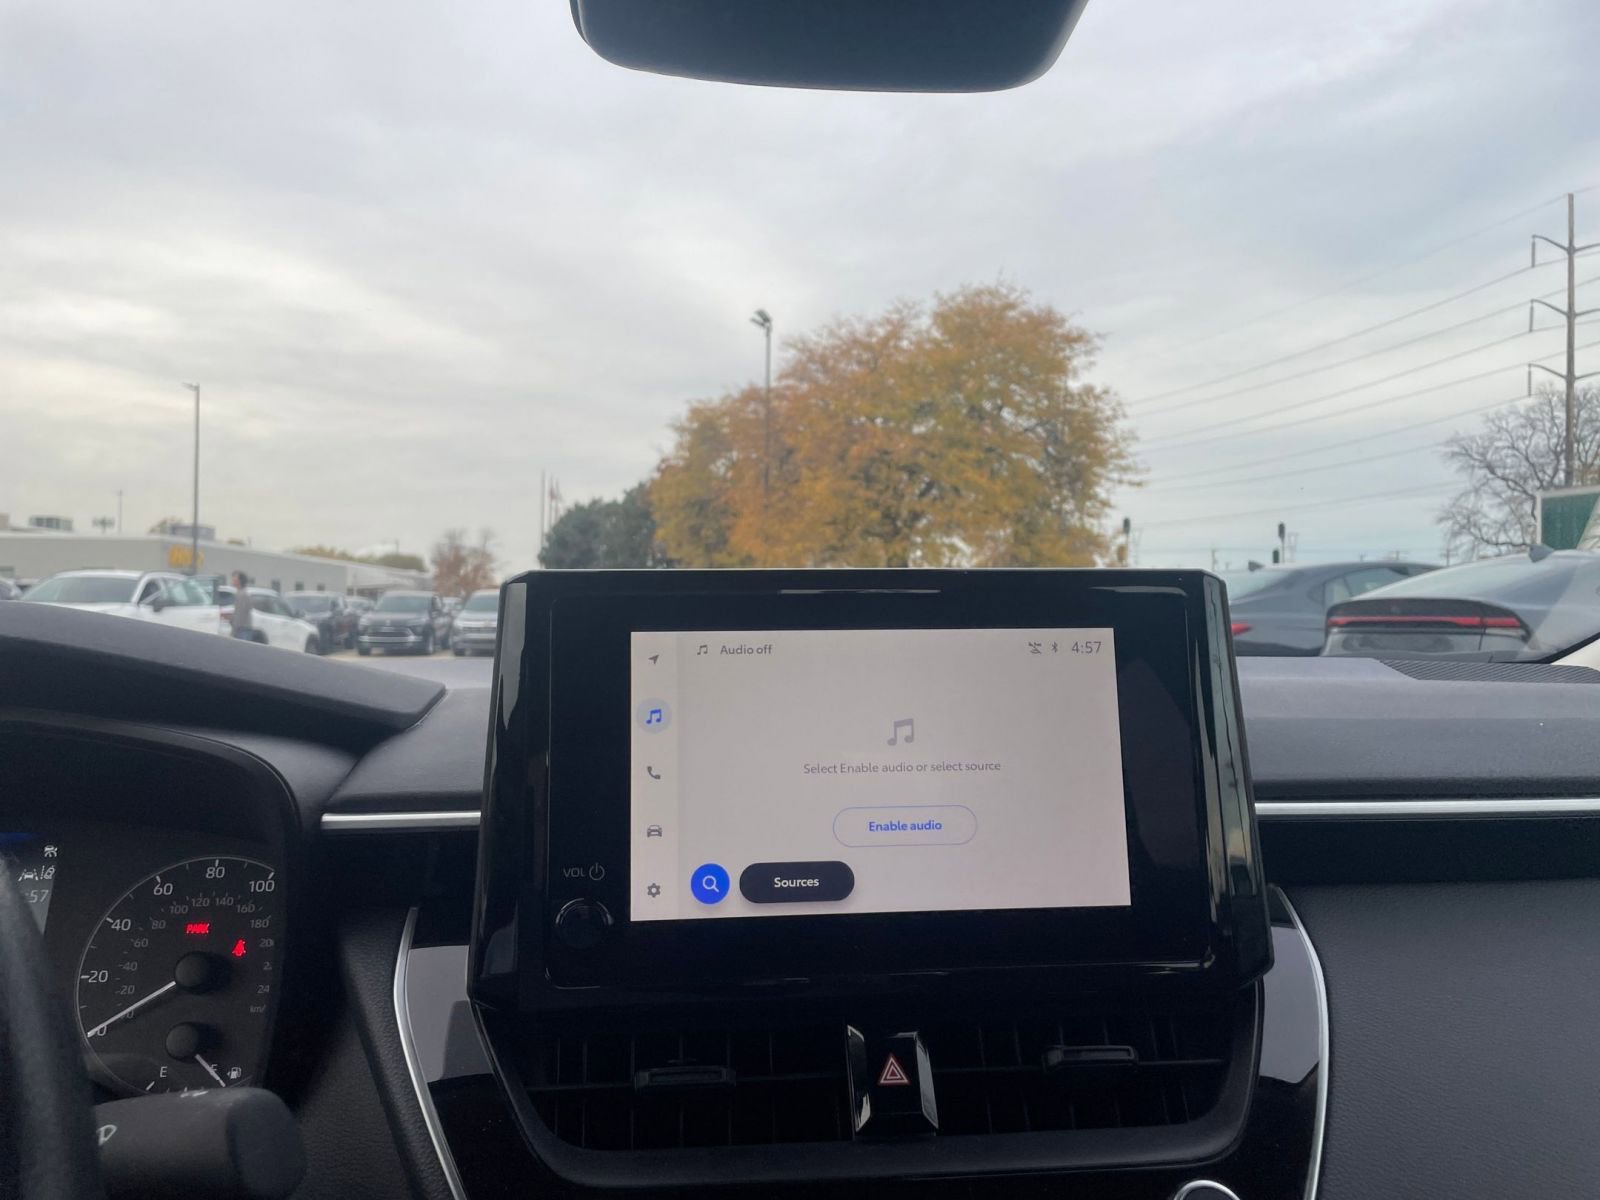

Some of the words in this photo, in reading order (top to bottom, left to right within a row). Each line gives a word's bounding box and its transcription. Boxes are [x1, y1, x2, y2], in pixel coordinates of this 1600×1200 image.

[720, 644, 754, 656] Audio
[756, 644, 773, 655] off
[1071, 641, 1102, 655] 4:57
[803, 763, 838, 775] Select
[840, 762, 880, 774] Enable
[881, 761, 915, 774] audio
[915, 763, 928, 773] or
[930, 760, 963, 773] select
[964, 762, 1001, 772] source
[868, 819, 909, 833] Enable
[910, 819, 943, 832] audio
[205, 866, 226, 879] 80
[562, 866, 586, 878] VOL
[248, 880, 275, 892] 100
[773, 875, 820, 888] Sources
[153, 882, 174, 896] 60
[191, 897, 210, 907] 120
[215, 896, 234, 906] 140
[169, 903, 189, 914] 100
[237, 903, 256, 913] 160
[111, 918, 132, 931] 40
[151, 919, 167, 930] 80
[250, 918, 270, 928] 180
[133, 937, 149, 948] 60
[259, 938, 275, 948] 20
[123, 961, 138, 972] 40
[88, 970, 109, 983] 20
[120, 984, 136, 995] 20
[257, 984, 270, 994] 24
[159, 1065, 168, 1078] E
